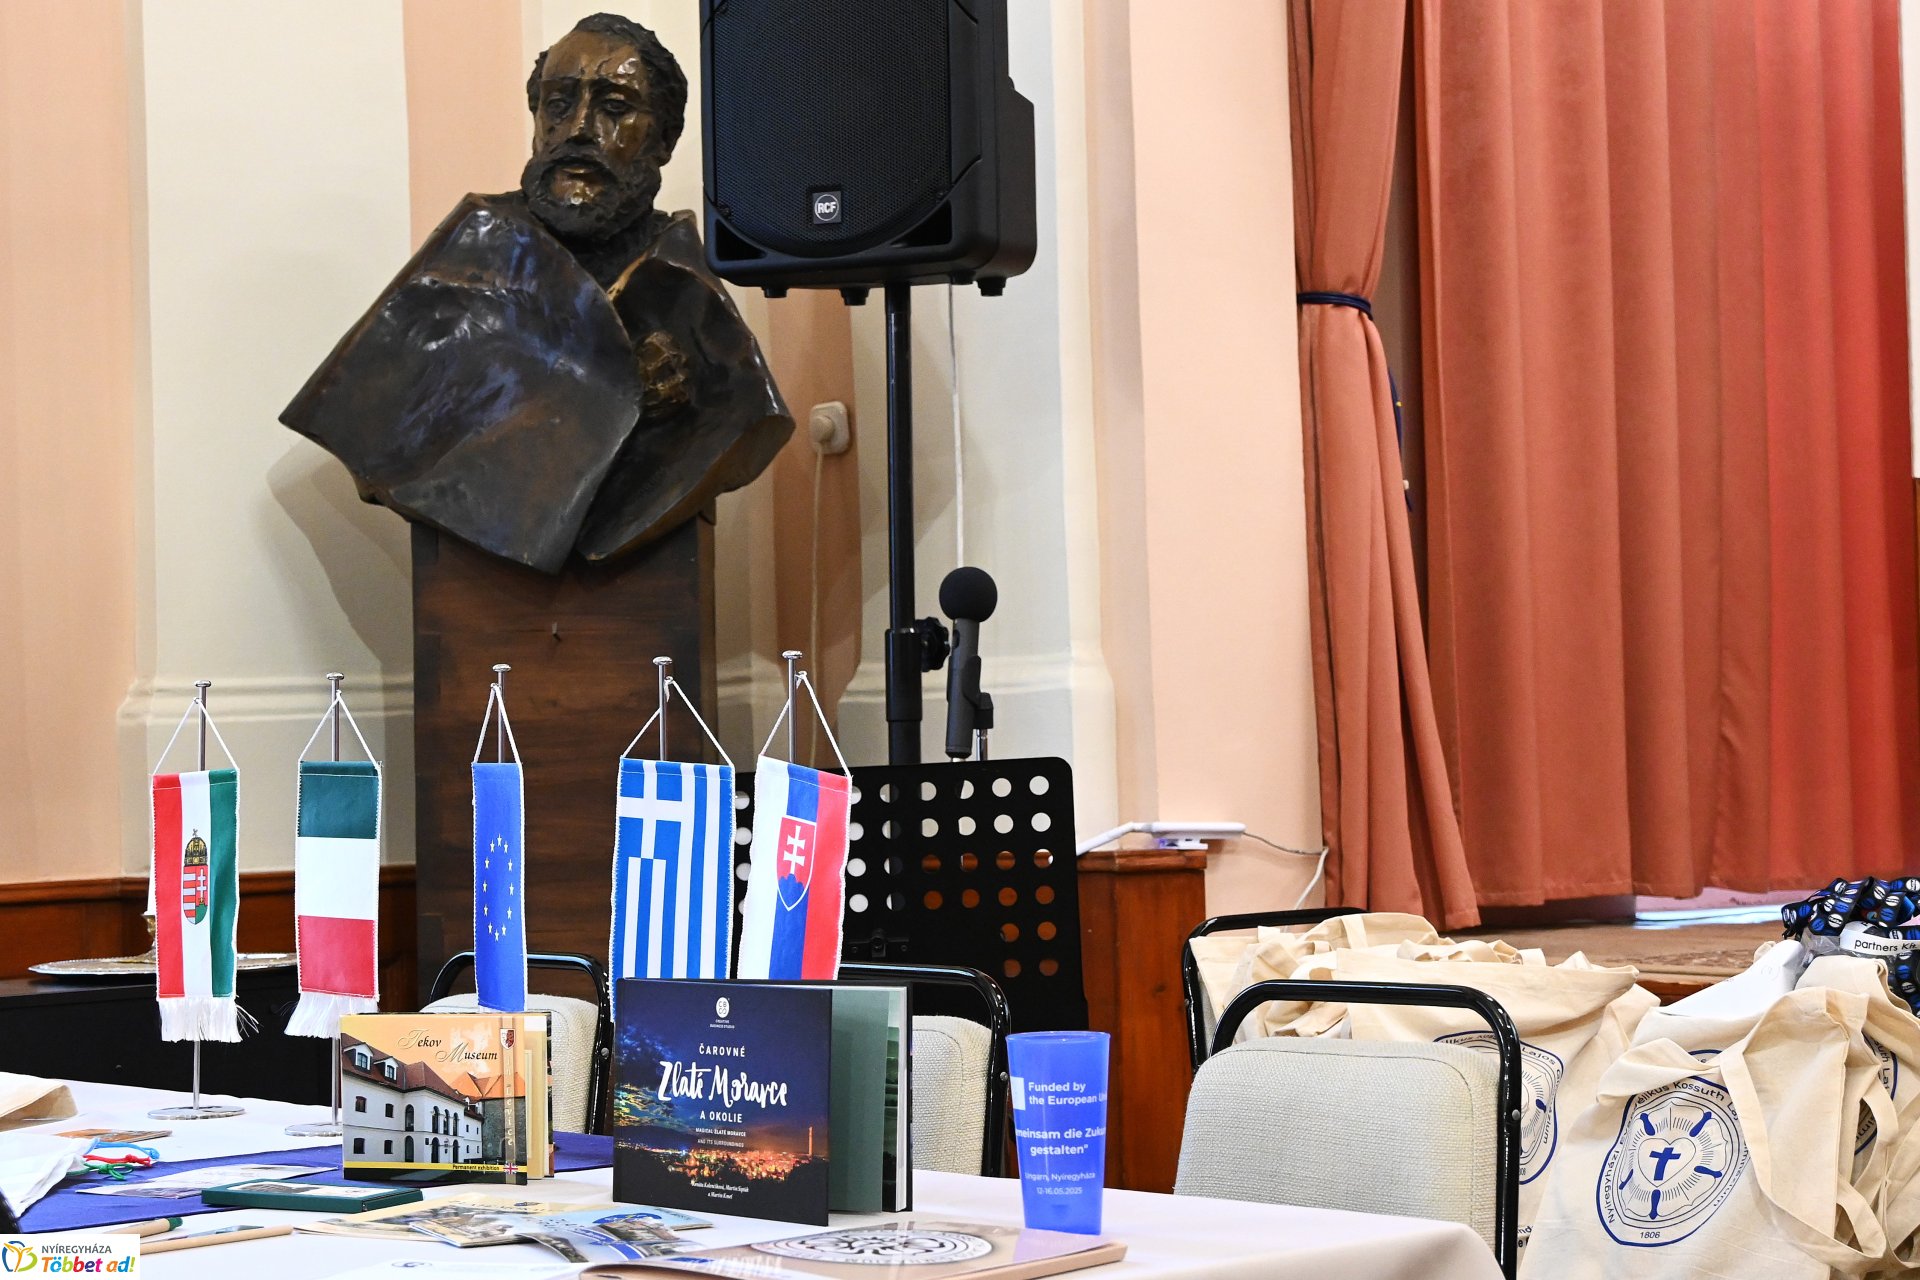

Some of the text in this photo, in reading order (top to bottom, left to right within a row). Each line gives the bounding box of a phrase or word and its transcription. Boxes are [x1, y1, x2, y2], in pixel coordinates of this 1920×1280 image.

[817, 201, 837, 214] RCF
[1854, 939, 1918, 952] partners Kft.
[397, 1029, 442, 1050] Tekov
[435, 1042, 498, 1063] Museum
[699, 1043, 746, 1058] ČAROVNÉ
[1522, 1047, 1556, 1066] Lajos
[657, 1061, 788, 1108] Zlaté Moravce
[1028, 1082, 1087, 1093] Funded by
[1672, 1081, 1725, 1101] Kossuth
[1029, 1095, 1045, 1105] the
[1047, 1095, 1097, 1106] European
[699, 1110, 743, 1123] A OKOLIE
[1063, 1128, 1083, 1139] die
[1640, 1231, 1660, 1239] 1806
